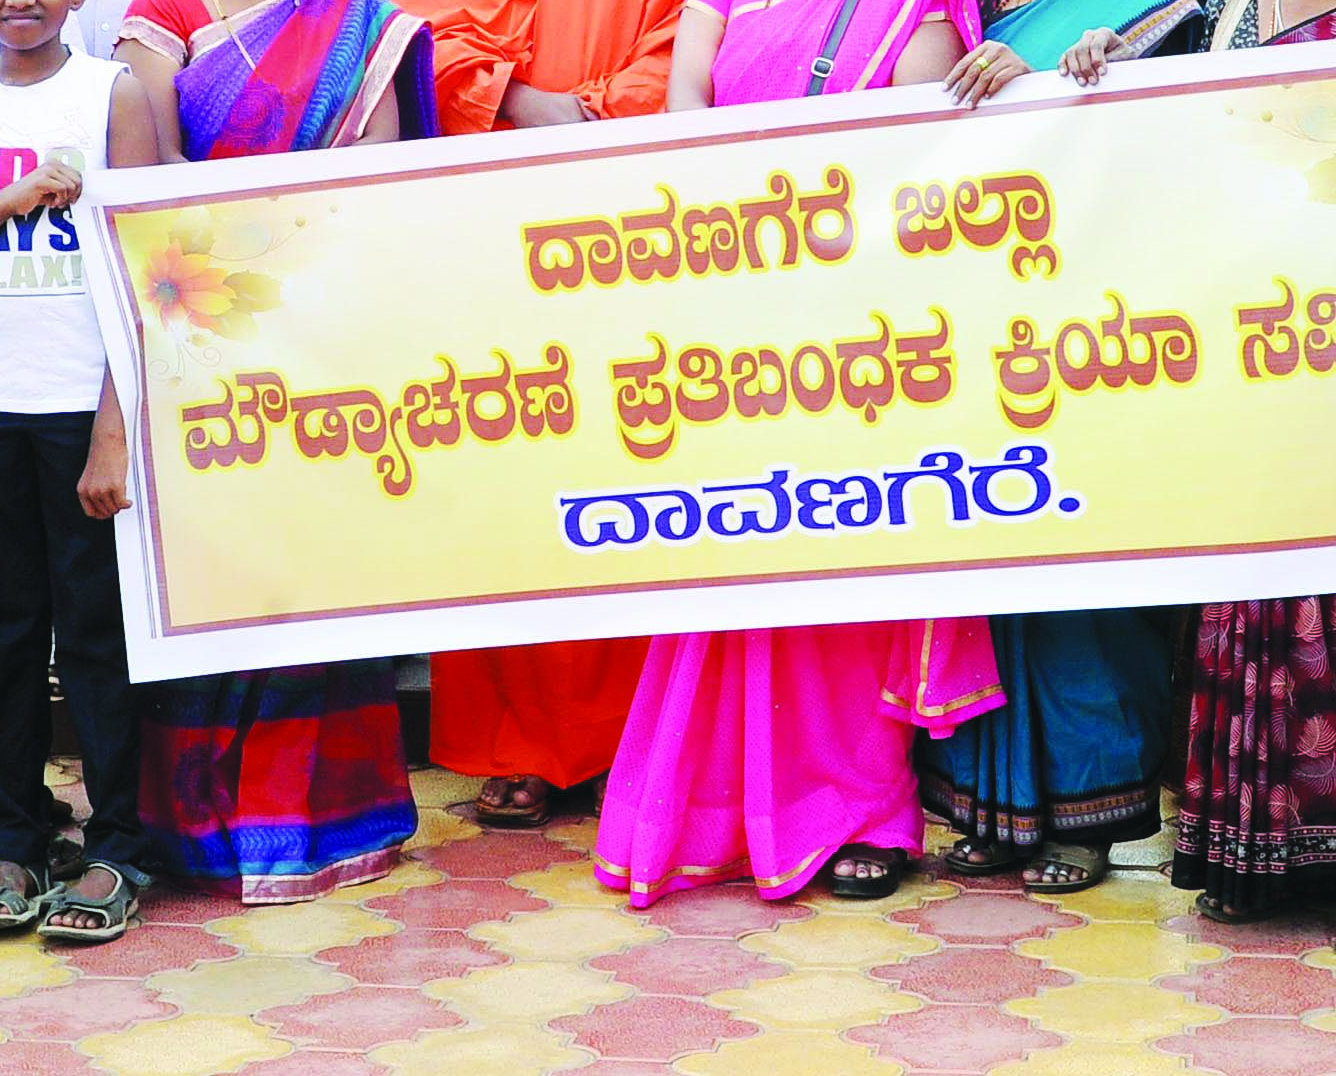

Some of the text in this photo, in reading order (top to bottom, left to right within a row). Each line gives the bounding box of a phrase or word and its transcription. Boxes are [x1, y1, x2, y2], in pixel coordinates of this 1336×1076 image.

[525, 168, 1058, 290] ದಾವಣಗೆರೆ ಜಿಲ್ಲಾ
[612, 308, 952, 459] ಪ್ರತಿಬಂಧಕ
[995, 291, 1198, 429] ಕ್ರಿಯಾ
[560, 445, 1082, 544] ದಾವಣಗೆರೆ.
